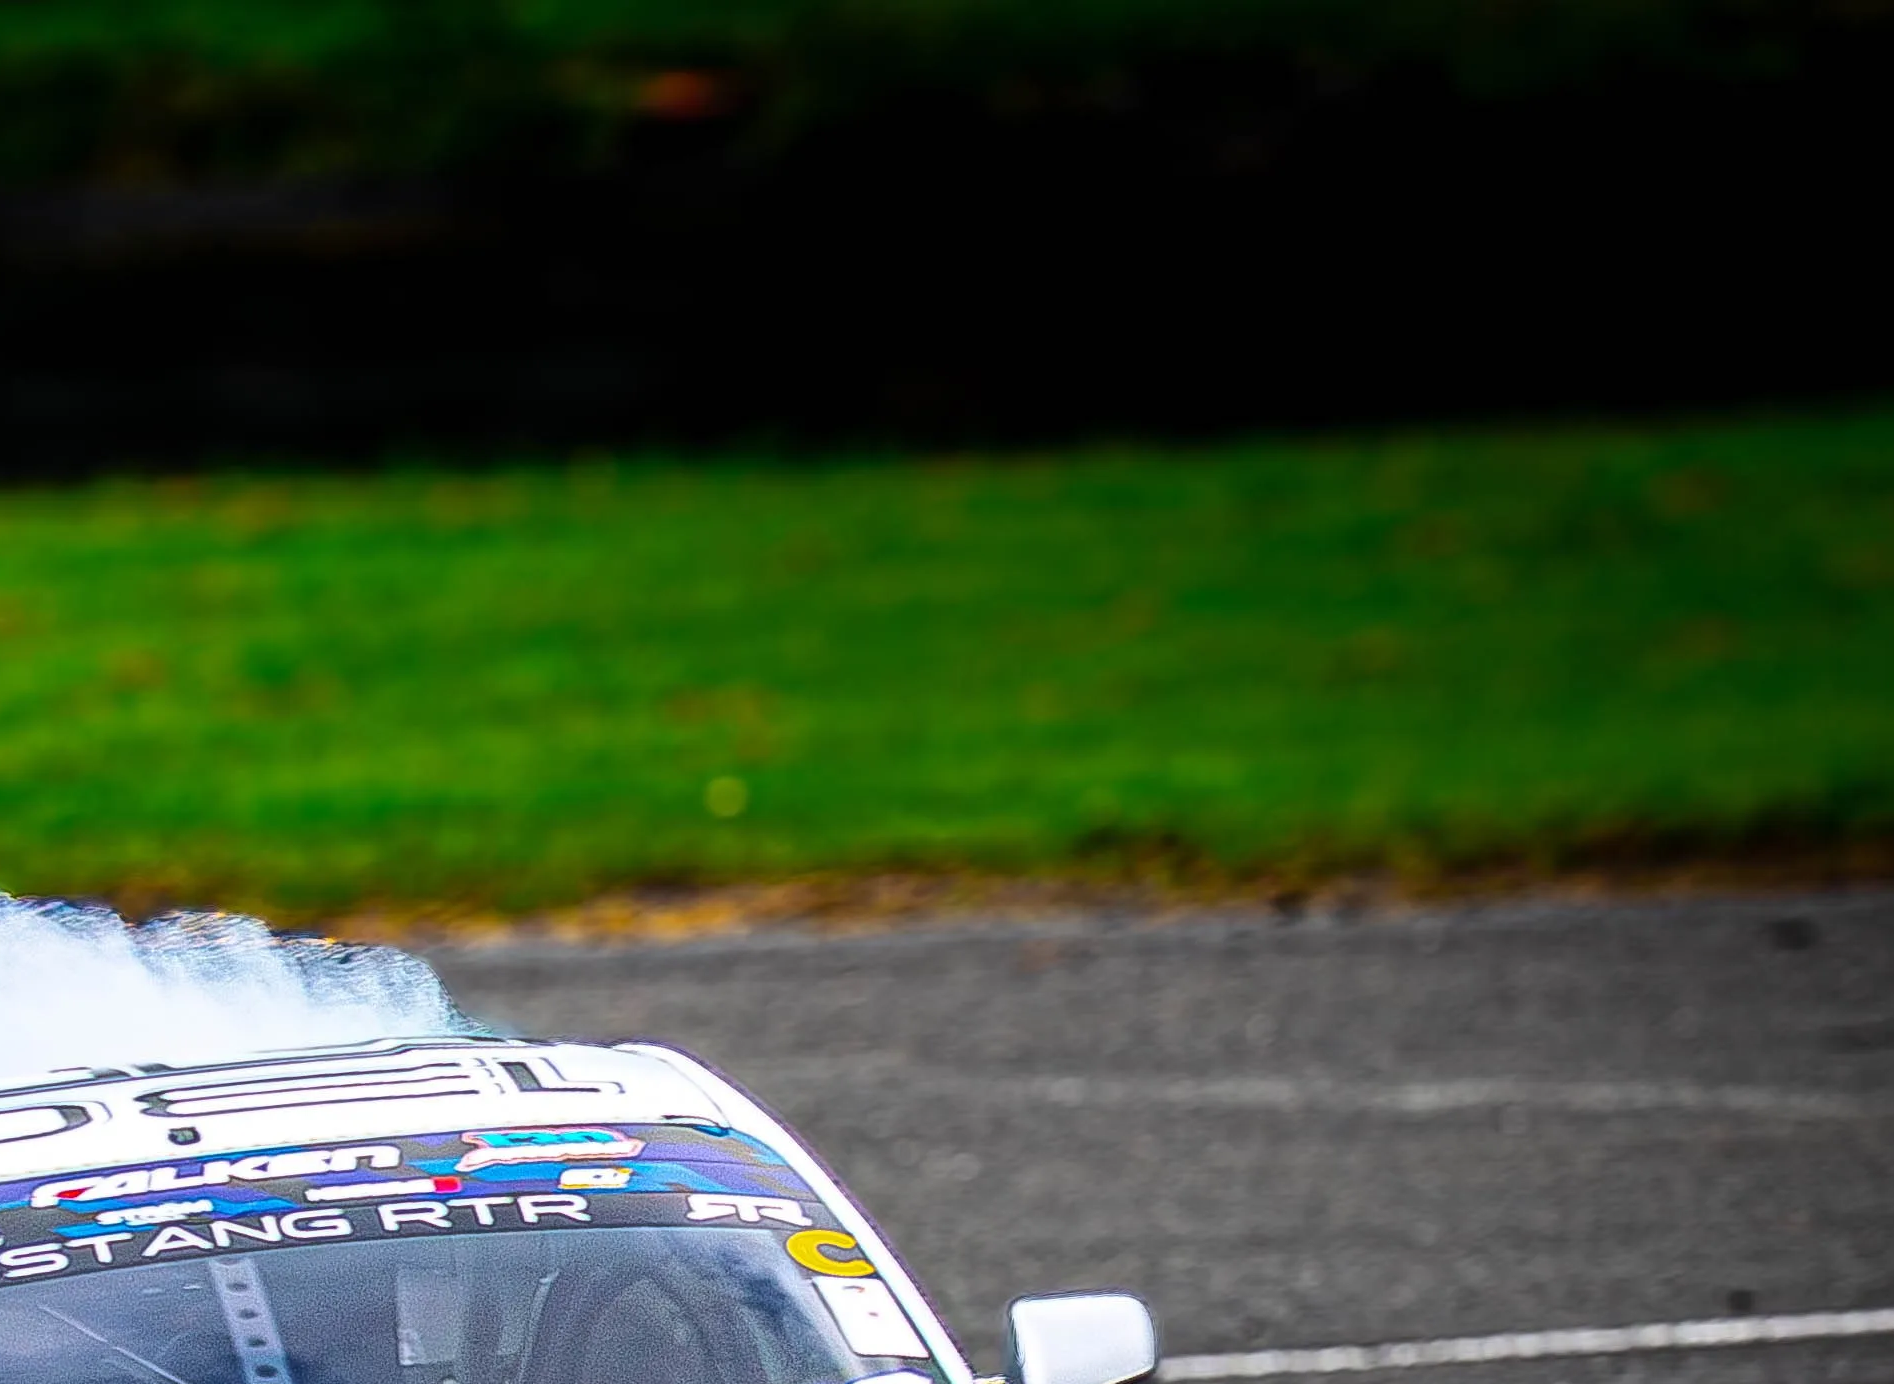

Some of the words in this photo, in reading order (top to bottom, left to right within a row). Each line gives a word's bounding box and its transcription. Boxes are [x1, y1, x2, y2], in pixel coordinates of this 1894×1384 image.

[29, 1144, 402, 1208] FALKEN
[378, 1193, 592, 1232] RTR
[786, 1229, 878, 1277] C
